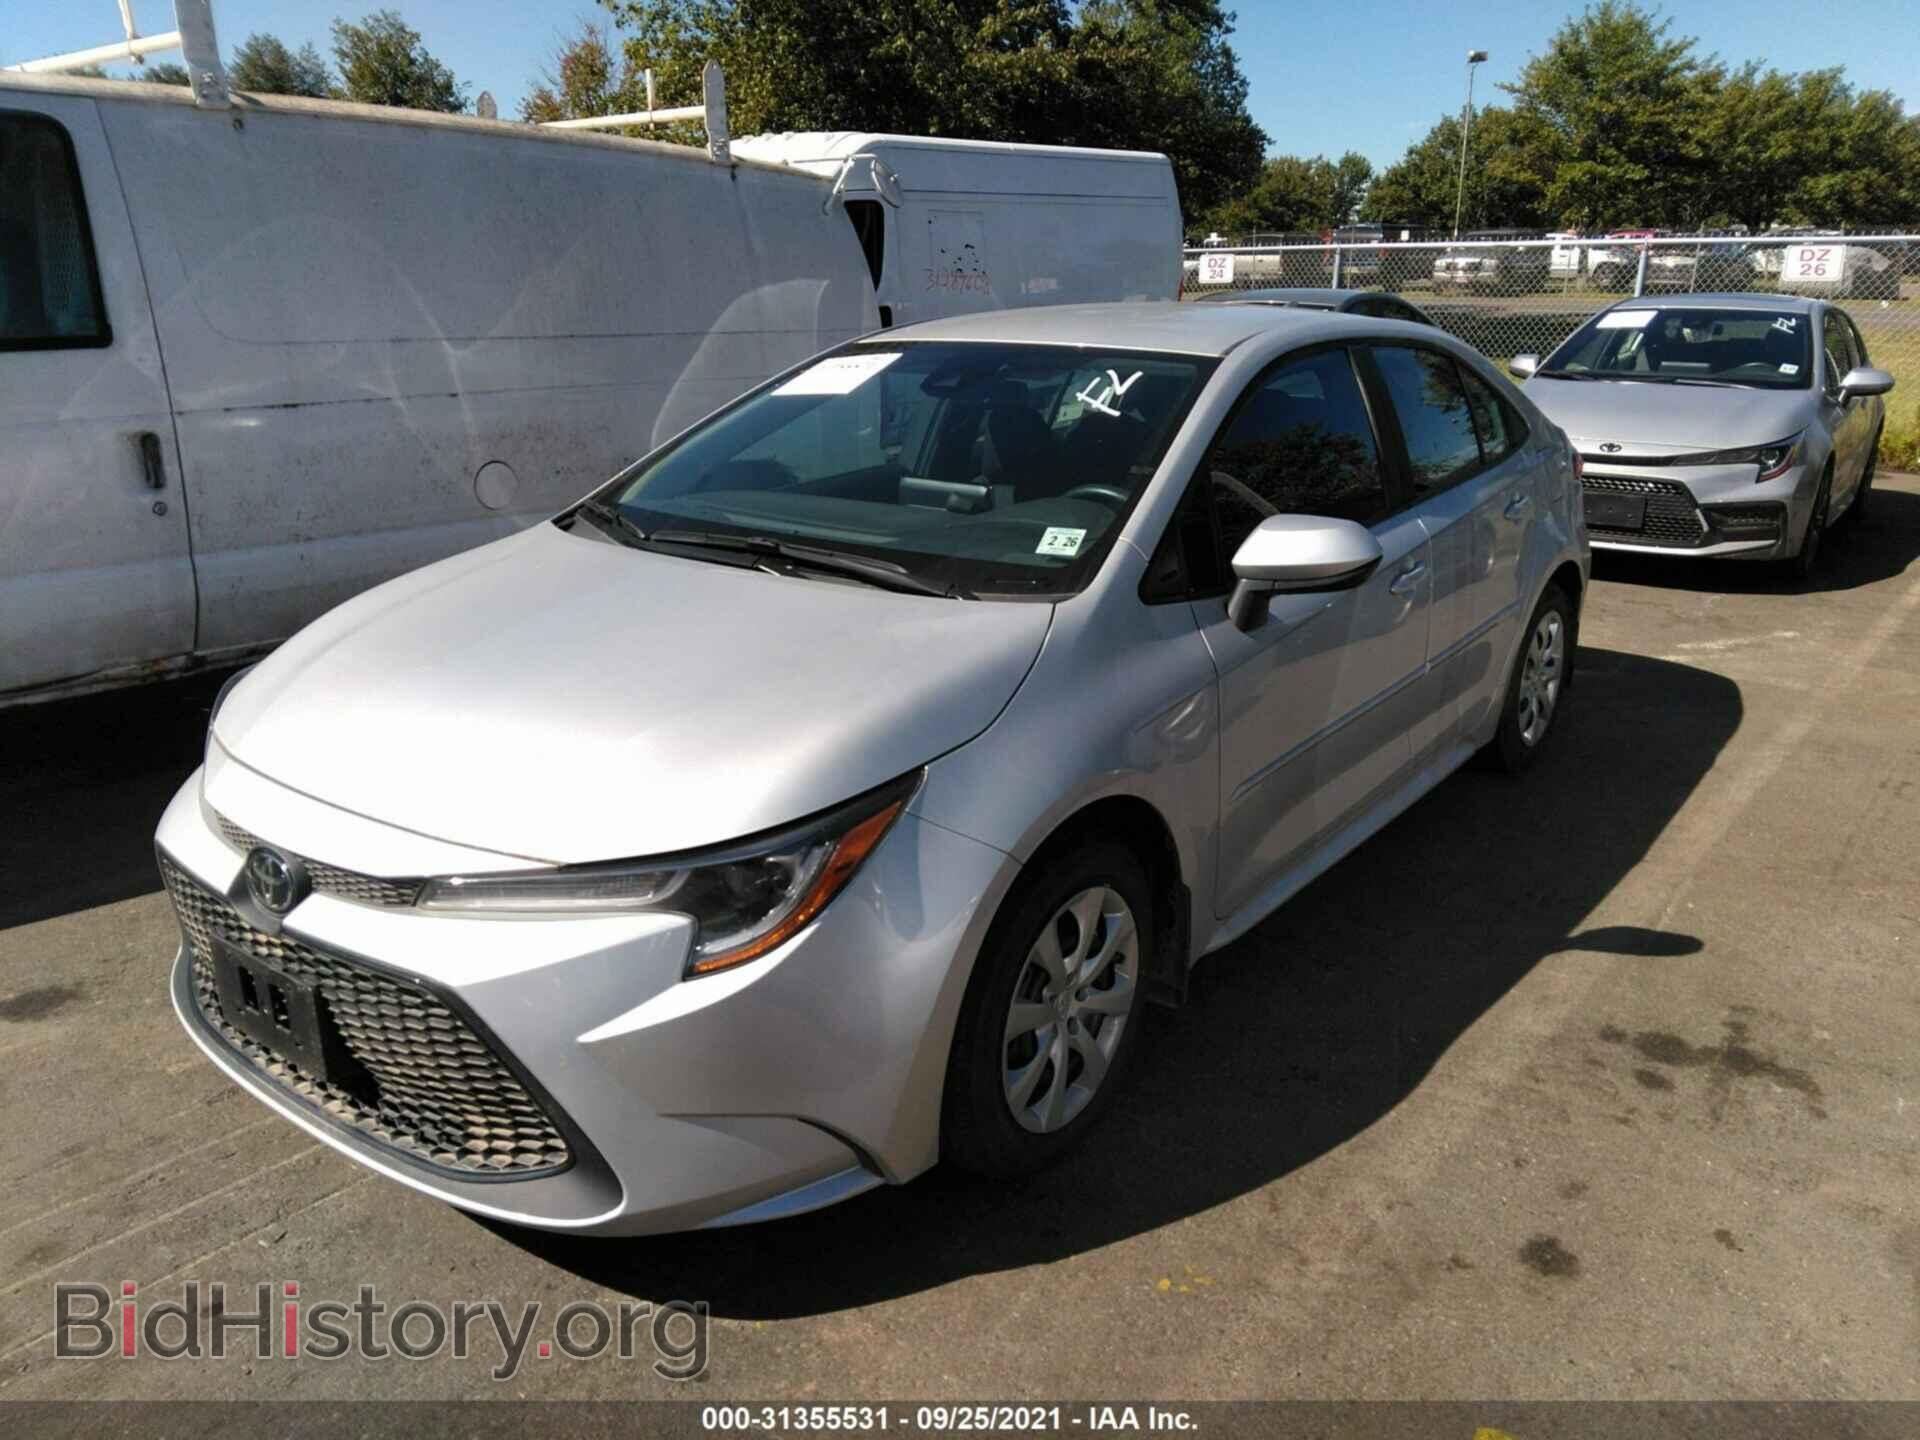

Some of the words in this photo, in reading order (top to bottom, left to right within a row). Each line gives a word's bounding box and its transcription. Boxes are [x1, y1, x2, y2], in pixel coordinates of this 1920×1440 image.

[1801, 248, 1831, 262] DZ
[1207, 257, 1226, 269] DZ
[1208, 269, 1224, 279] 24
[1799, 263, 1826, 276] 26
